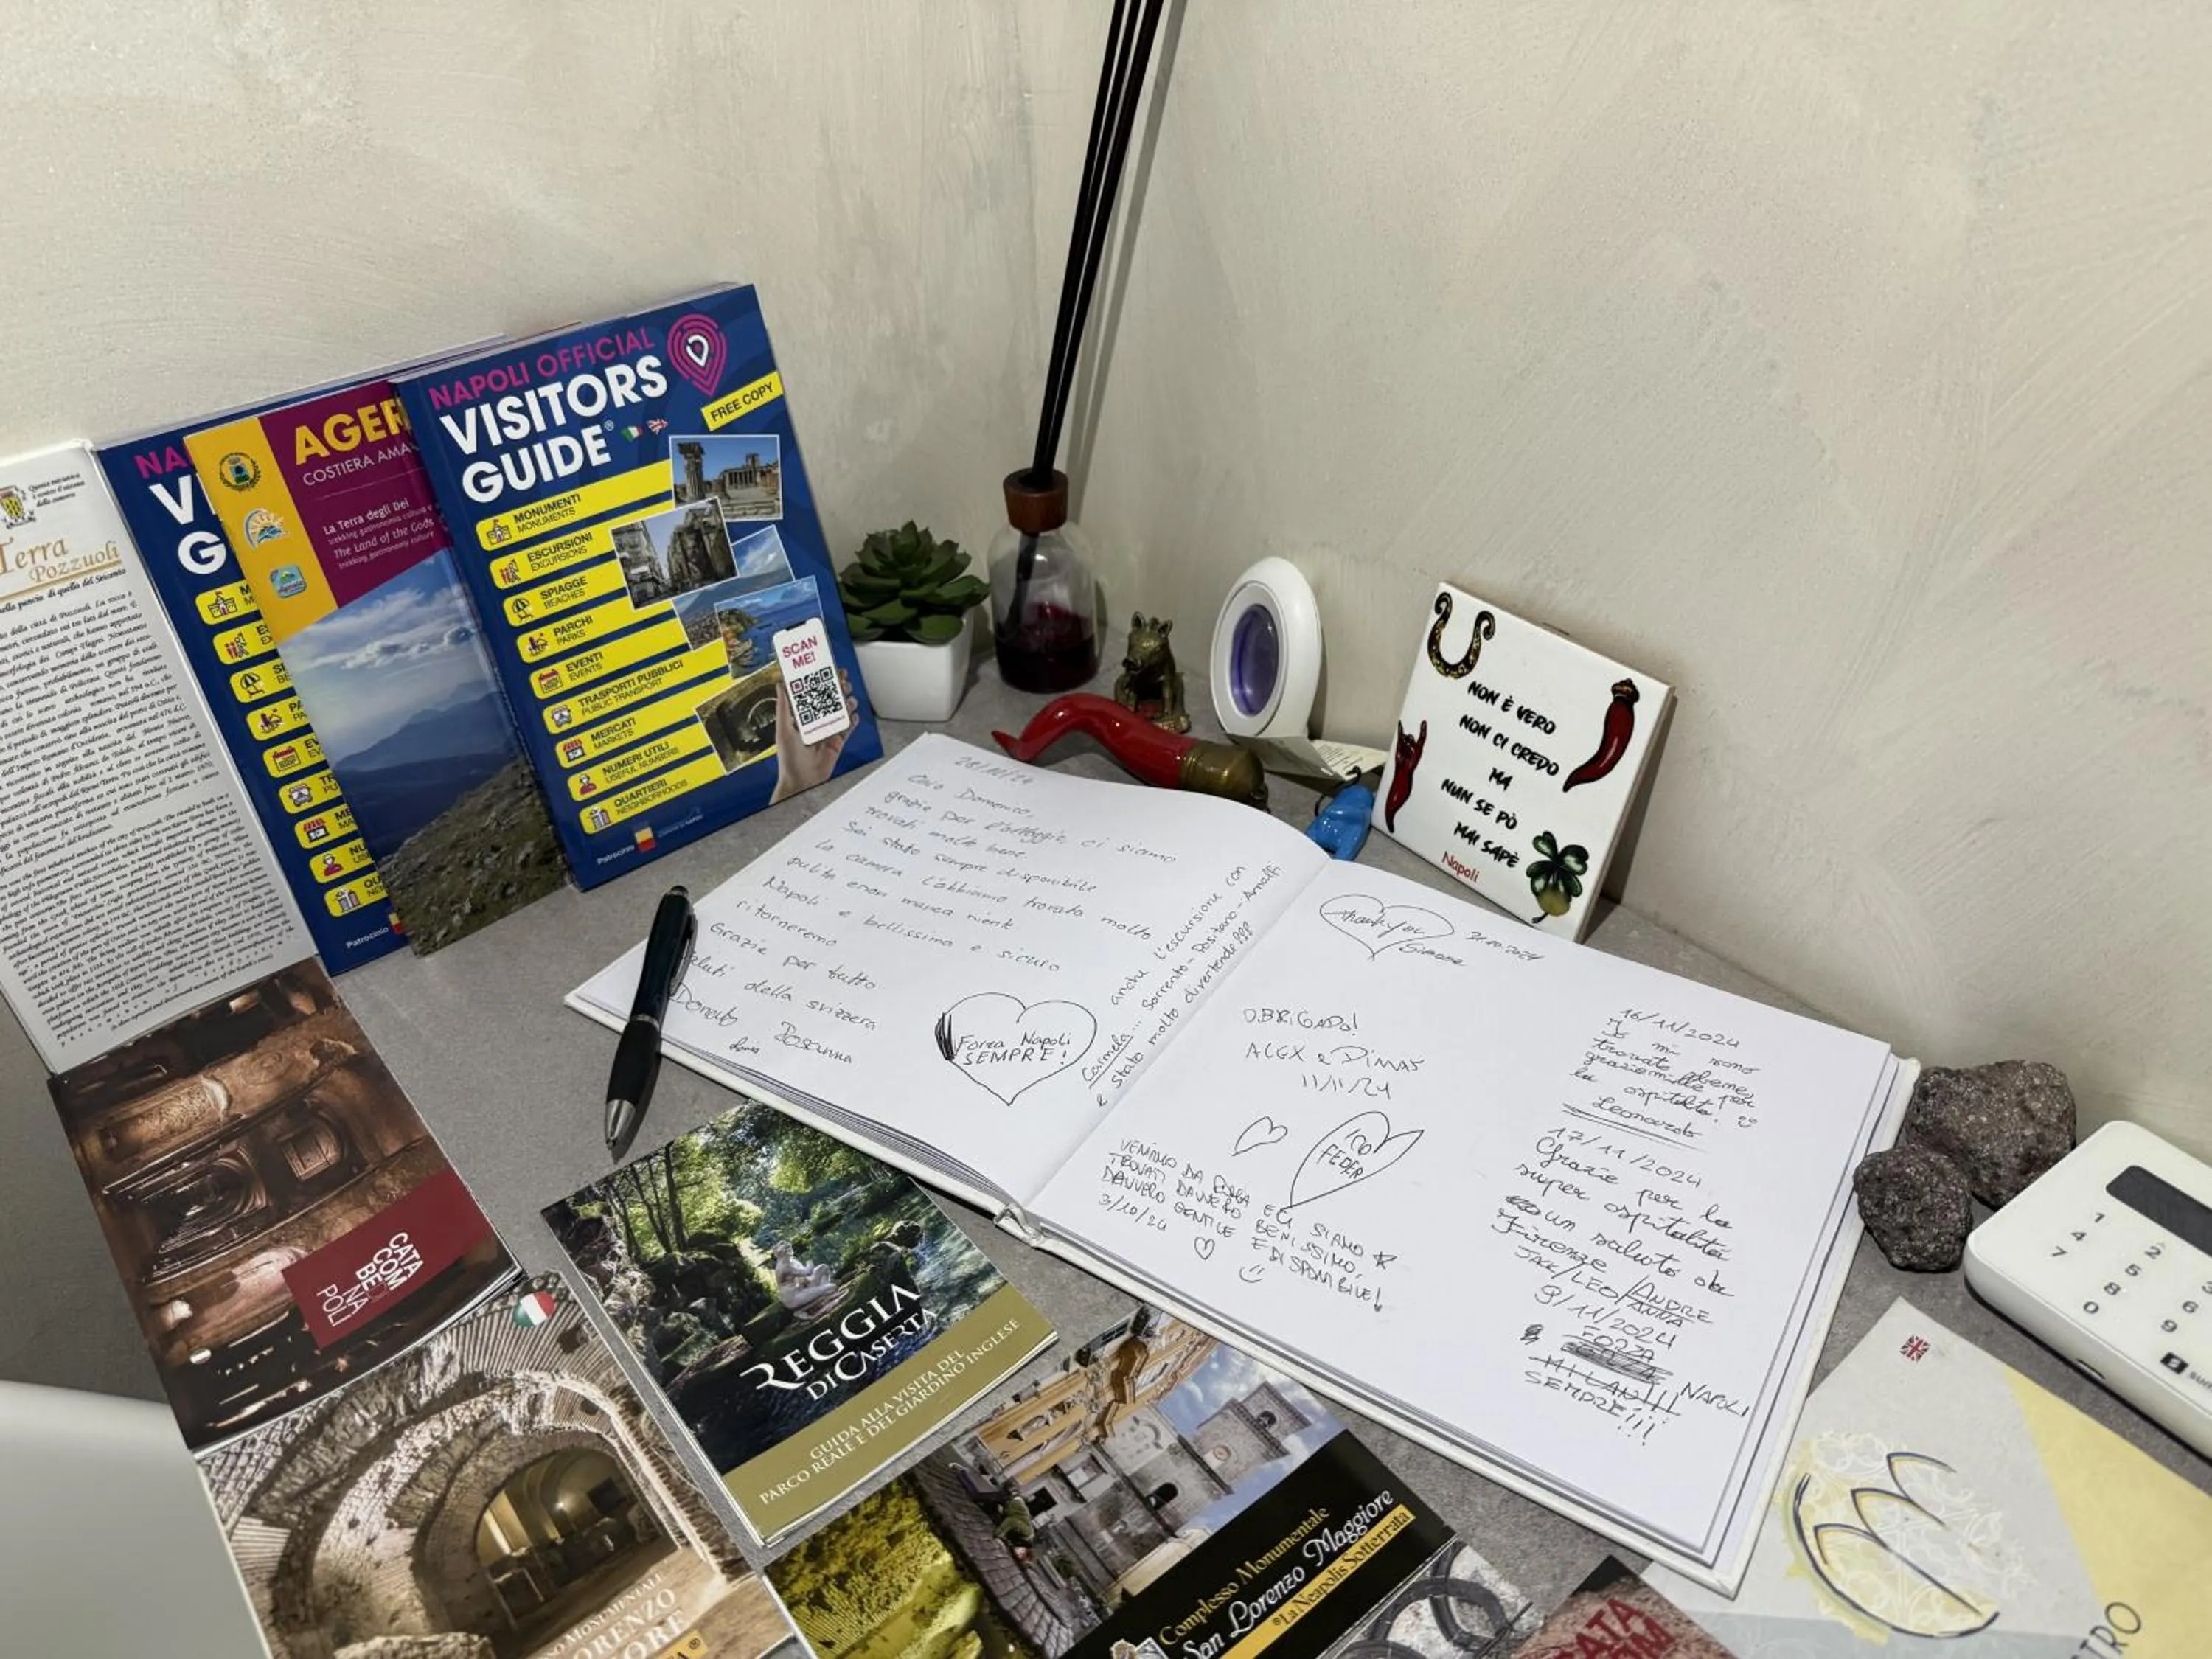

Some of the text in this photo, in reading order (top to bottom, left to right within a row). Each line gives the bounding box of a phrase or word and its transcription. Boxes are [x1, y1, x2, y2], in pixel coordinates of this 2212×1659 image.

[428, 328, 655, 410] NAPOLI OFFICIAL
[439, 355, 667, 455] VISITORS
[710, 381, 773, 422] FREE COPY
[303, 454, 375, 486] COSTIERA
[323, 524, 336, 535] La
[337, 515, 364, 530] Terra
[366, 504, 392, 521] degli
[513, 493, 581, 523] MONUMENTI
[517, 507, 576, 532] MONUMENTS
[333, 545, 352, 560] The
[354, 535, 378, 553] Land
[380, 533, 390, 546] of
[392, 526, 408, 539] the
[527, 532, 593, 562] ESCURSIONI
[29, 540, 120, 583] Pozzuoli
[530, 546, 588, 572] EXCURSIONS
[540, 576, 588, 599] SPIAGGE
[544, 588, 585, 609] BEACHES
[554, 615, 593, 637] PARCHI
[557, 629, 585, 645] PARKS
[566, 651, 603, 672] EVENTI
[782, 636, 818, 658] SCAN
[792, 651, 815, 669] ME!
[568, 662, 602, 681] EVENTS
[578, 659, 684, 707] TRASPORTI PUBBLICI
[582, 678, 663, 715] PUBLIC TRANSPORT
[1467, 680, 1557, 735] NON È VERO
[591, 717, 636, 742] MERCATI
[594, 729, 635, 749] MARKETS
[602, 741, 669, 775] NUMERI UTILI
[1459, 714, 1560, 776] NON CI CREDO
[613, 778, 667, 807] QUARTIERI
[1489, 768, 1513, 791] MA
[1441, 779, 1519, 830] NUN SE PÒ
[1453, 821, 1521, 868] MAI SAPÈ
[1441, 851, 1481, 883] Napoli
[347, 927, 389, 948] Patrocinio
[1021, 1031, 1072, 1048] Napoli
[1544, 1210, 1576, 1231] un
[1700, 1203, 1733, 1229] la
[2093, 1212, 2106, 1224] 1
[2070, 1229, 2087, 1242] 4
[389, 1232, 424, 1279] CATA
[2051, 1246, 2068, 1259] 7
[2144, 1245, 2162, 1259] 2
[355, 1262, 383, 1291] BE
[373, 1248, 408, 1291] COM
[2124, 1264, 2142, 1277] 5
[342, 1283, 369, 1315] NA
[2104, 1282, 2121, 1295] 8
[316, 1283, 351, 1326] POLI
[2082, 1301, 2100, 1315] 0
[2182, 1300, 2199, 1313] 6
[739, 1283, 922, 1391] REGGIA
[2160, 1319, 2178, 1332] 9
[806, 1307, 939, 1401] DI CASERTA
[759, 1318, 1021, 1506] PARCO REALE E DEL GIARDINO INGLESE
[810, 1349, 965, 1461] GUIDA ALLA VISITA DEL
[1180, 1488, 1394, 1659] San Lorenzo Maggiore
[1292, 1511, 1411, 1609] Neapolis Sotterrata
[1158, 1506, 1330, 1646] Complesso Monumentale
[2070, 1601, 2141, 1659] TRO
